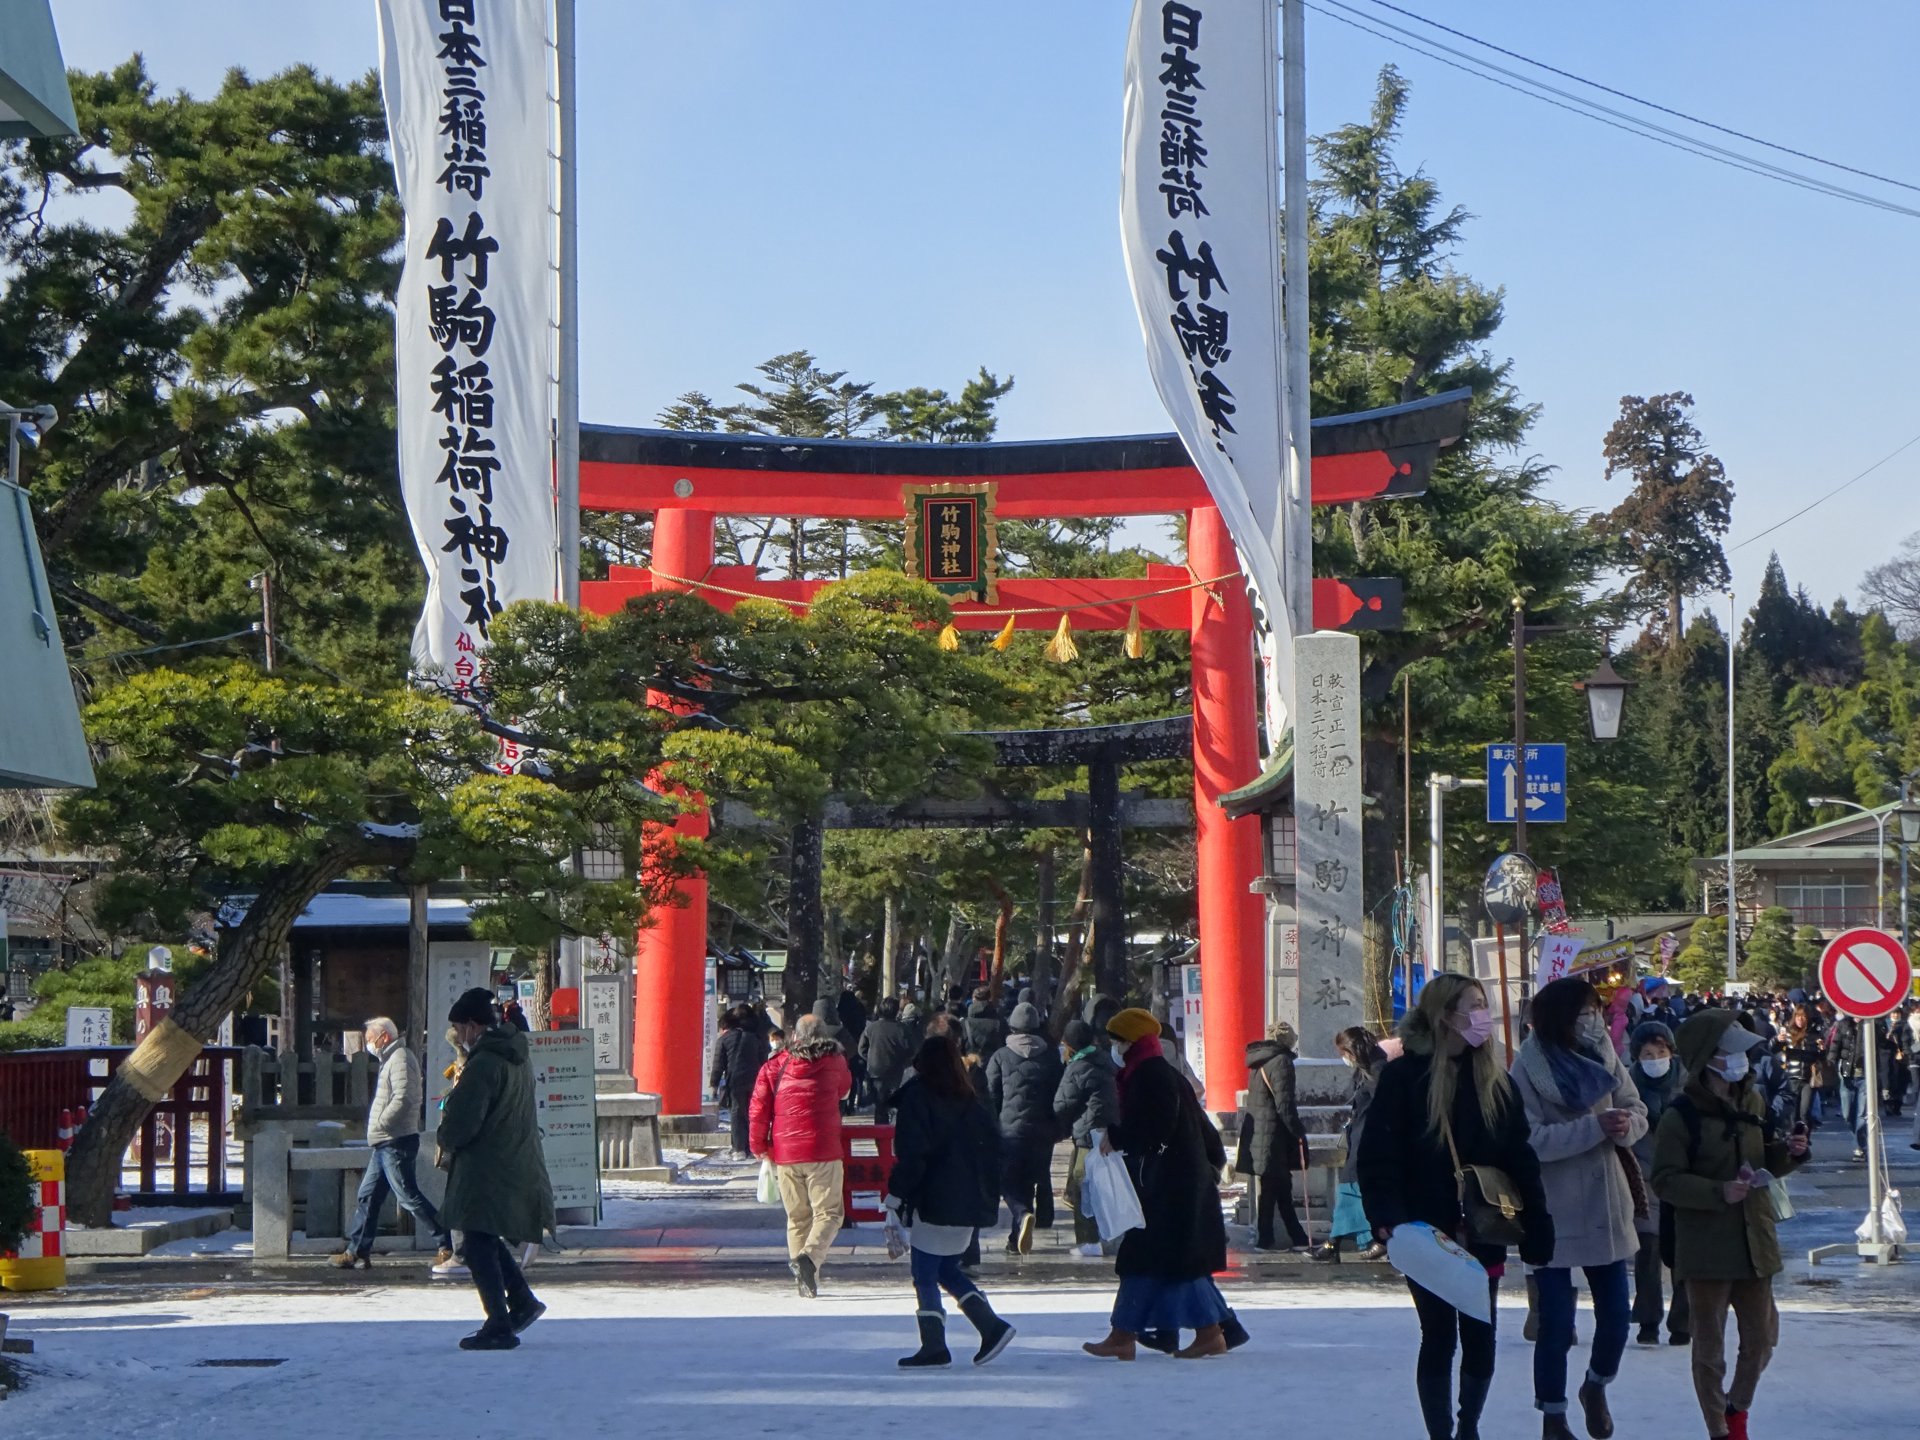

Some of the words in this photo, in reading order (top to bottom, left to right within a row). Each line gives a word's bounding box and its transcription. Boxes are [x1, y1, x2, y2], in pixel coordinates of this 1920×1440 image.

[941, 505, 961, 575] 竹駒神社
[1492, 749, 1538, 760] 車お所
[1526, 782, 1561, 794] 駐車場
[1308, 800, 1350, 1010] 竹駒神社
